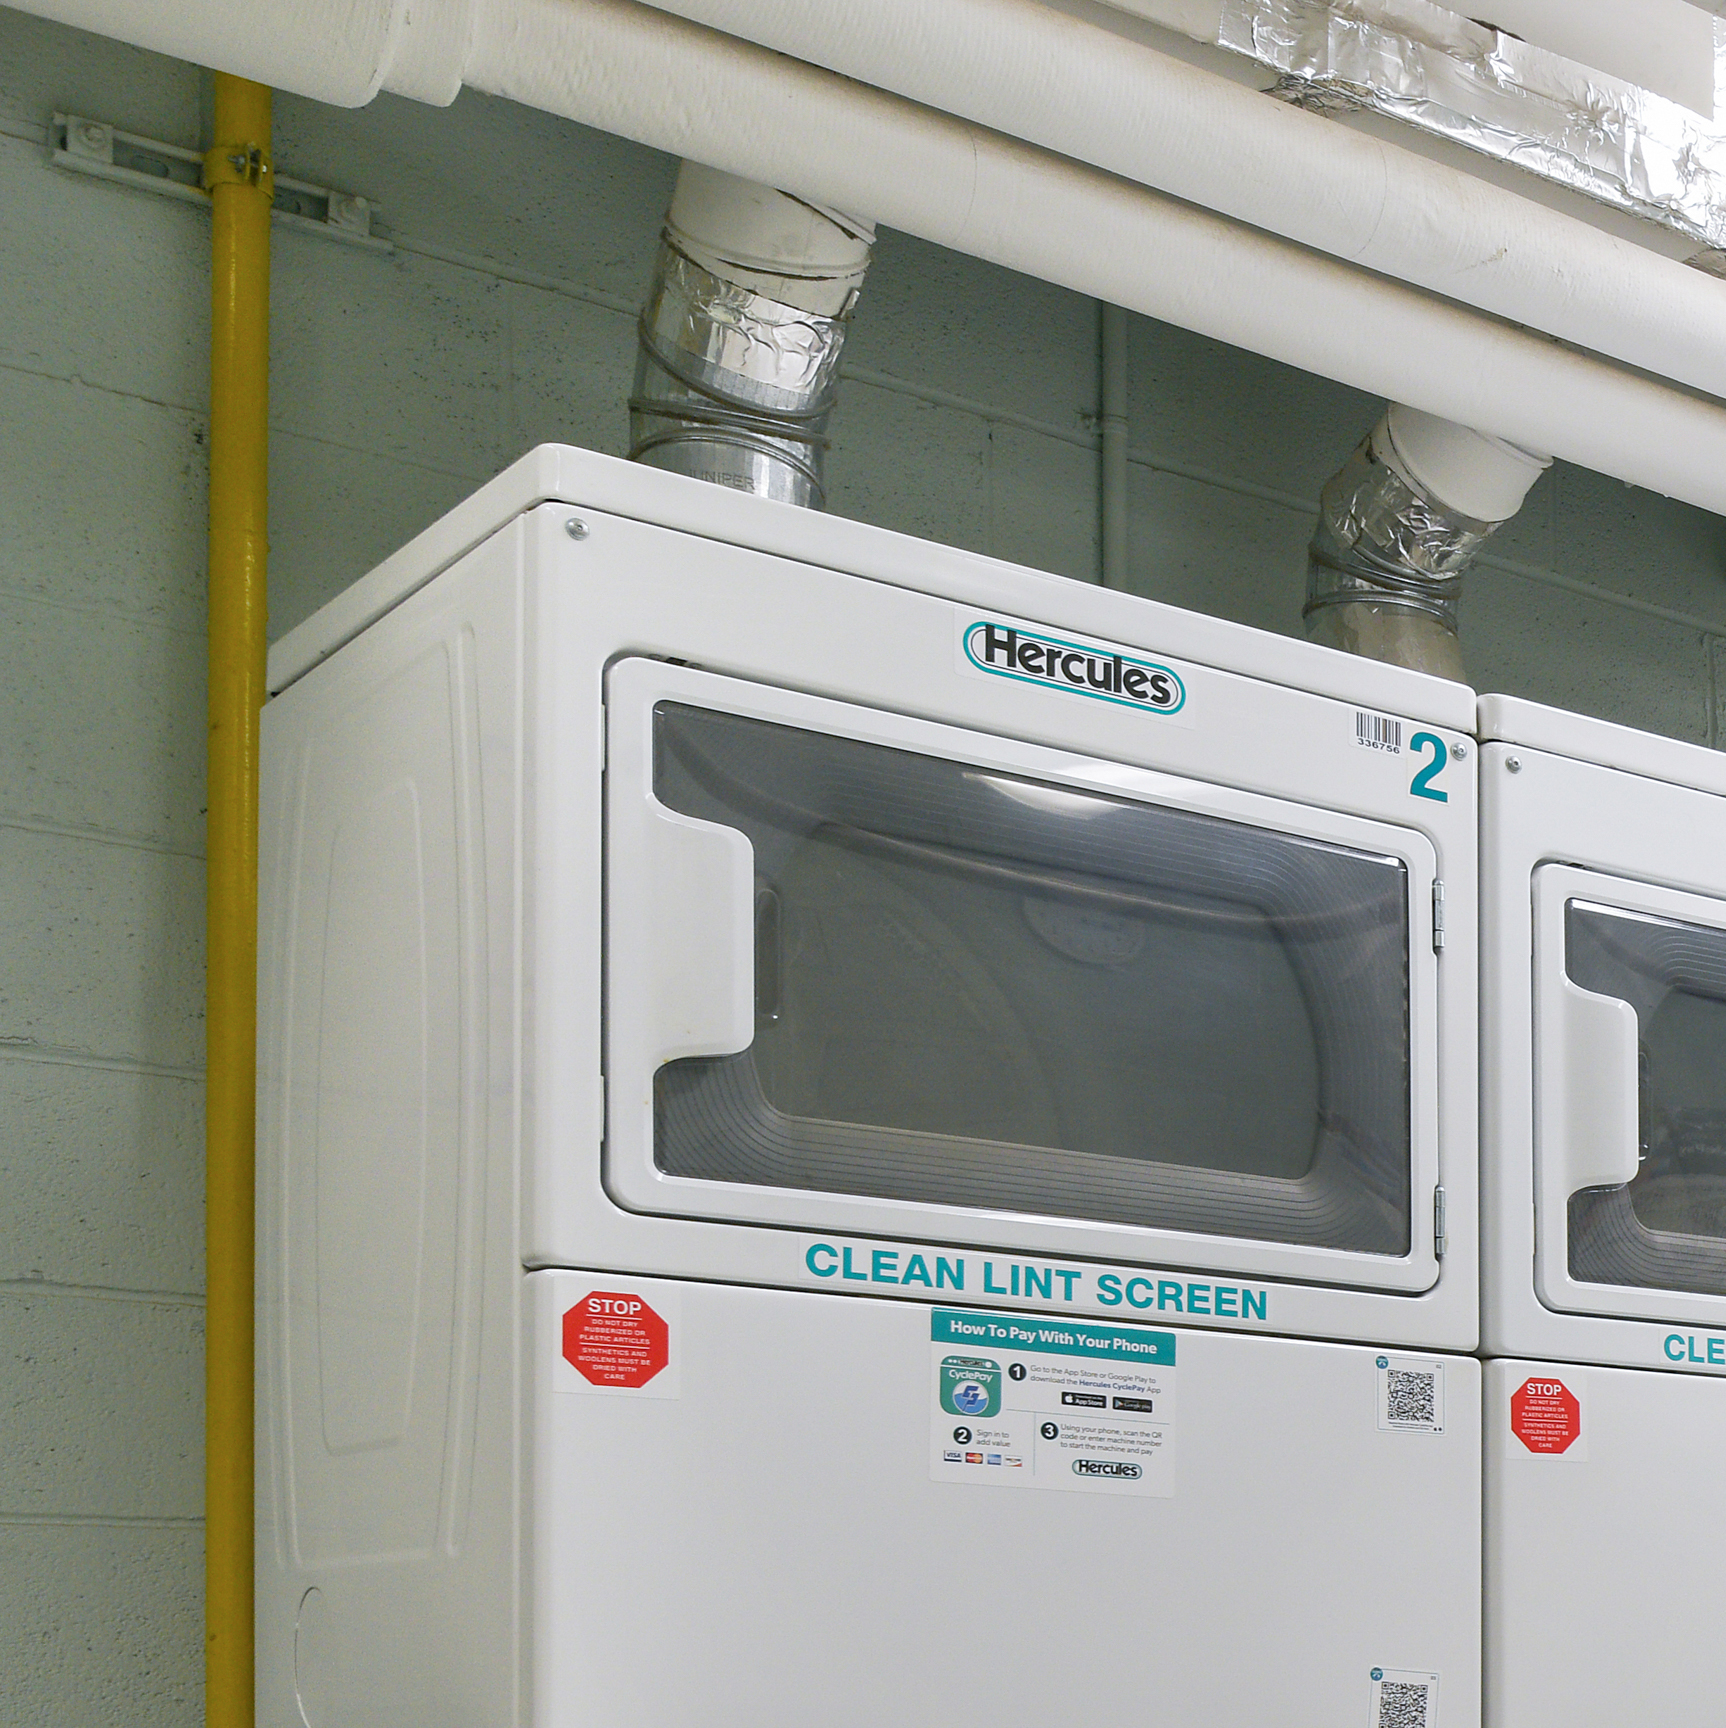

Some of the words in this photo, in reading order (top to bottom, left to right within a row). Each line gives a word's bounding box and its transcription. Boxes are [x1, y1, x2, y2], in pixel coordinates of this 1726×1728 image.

[985, 623, 1171, 704] Hercules
[1358, 738, 1400, 754] 336756
[1410, 732, 1448, 803] 2
[805, 1243, 965, 1292] CLEAN
[983, 1261, 1082, 1302] LINT
[1096, 1273, 1268, 1320] SCREEN
[588, 1298, 641, 1315] STOP
[951, 1321, 986, 1337] How
[988, 1325, 1007, 1338] To
[1010, 1327, 1036, 1344] Pay
[1039, 1329, 1074, 1345] With
[1077, 1334, 1111, 1349] Your
[1113, 1338, 1158, 1354] Phone
[1527, 1383, 1561, 1395] STOP
[1078, 1460, 1137, 1477] Hercules
